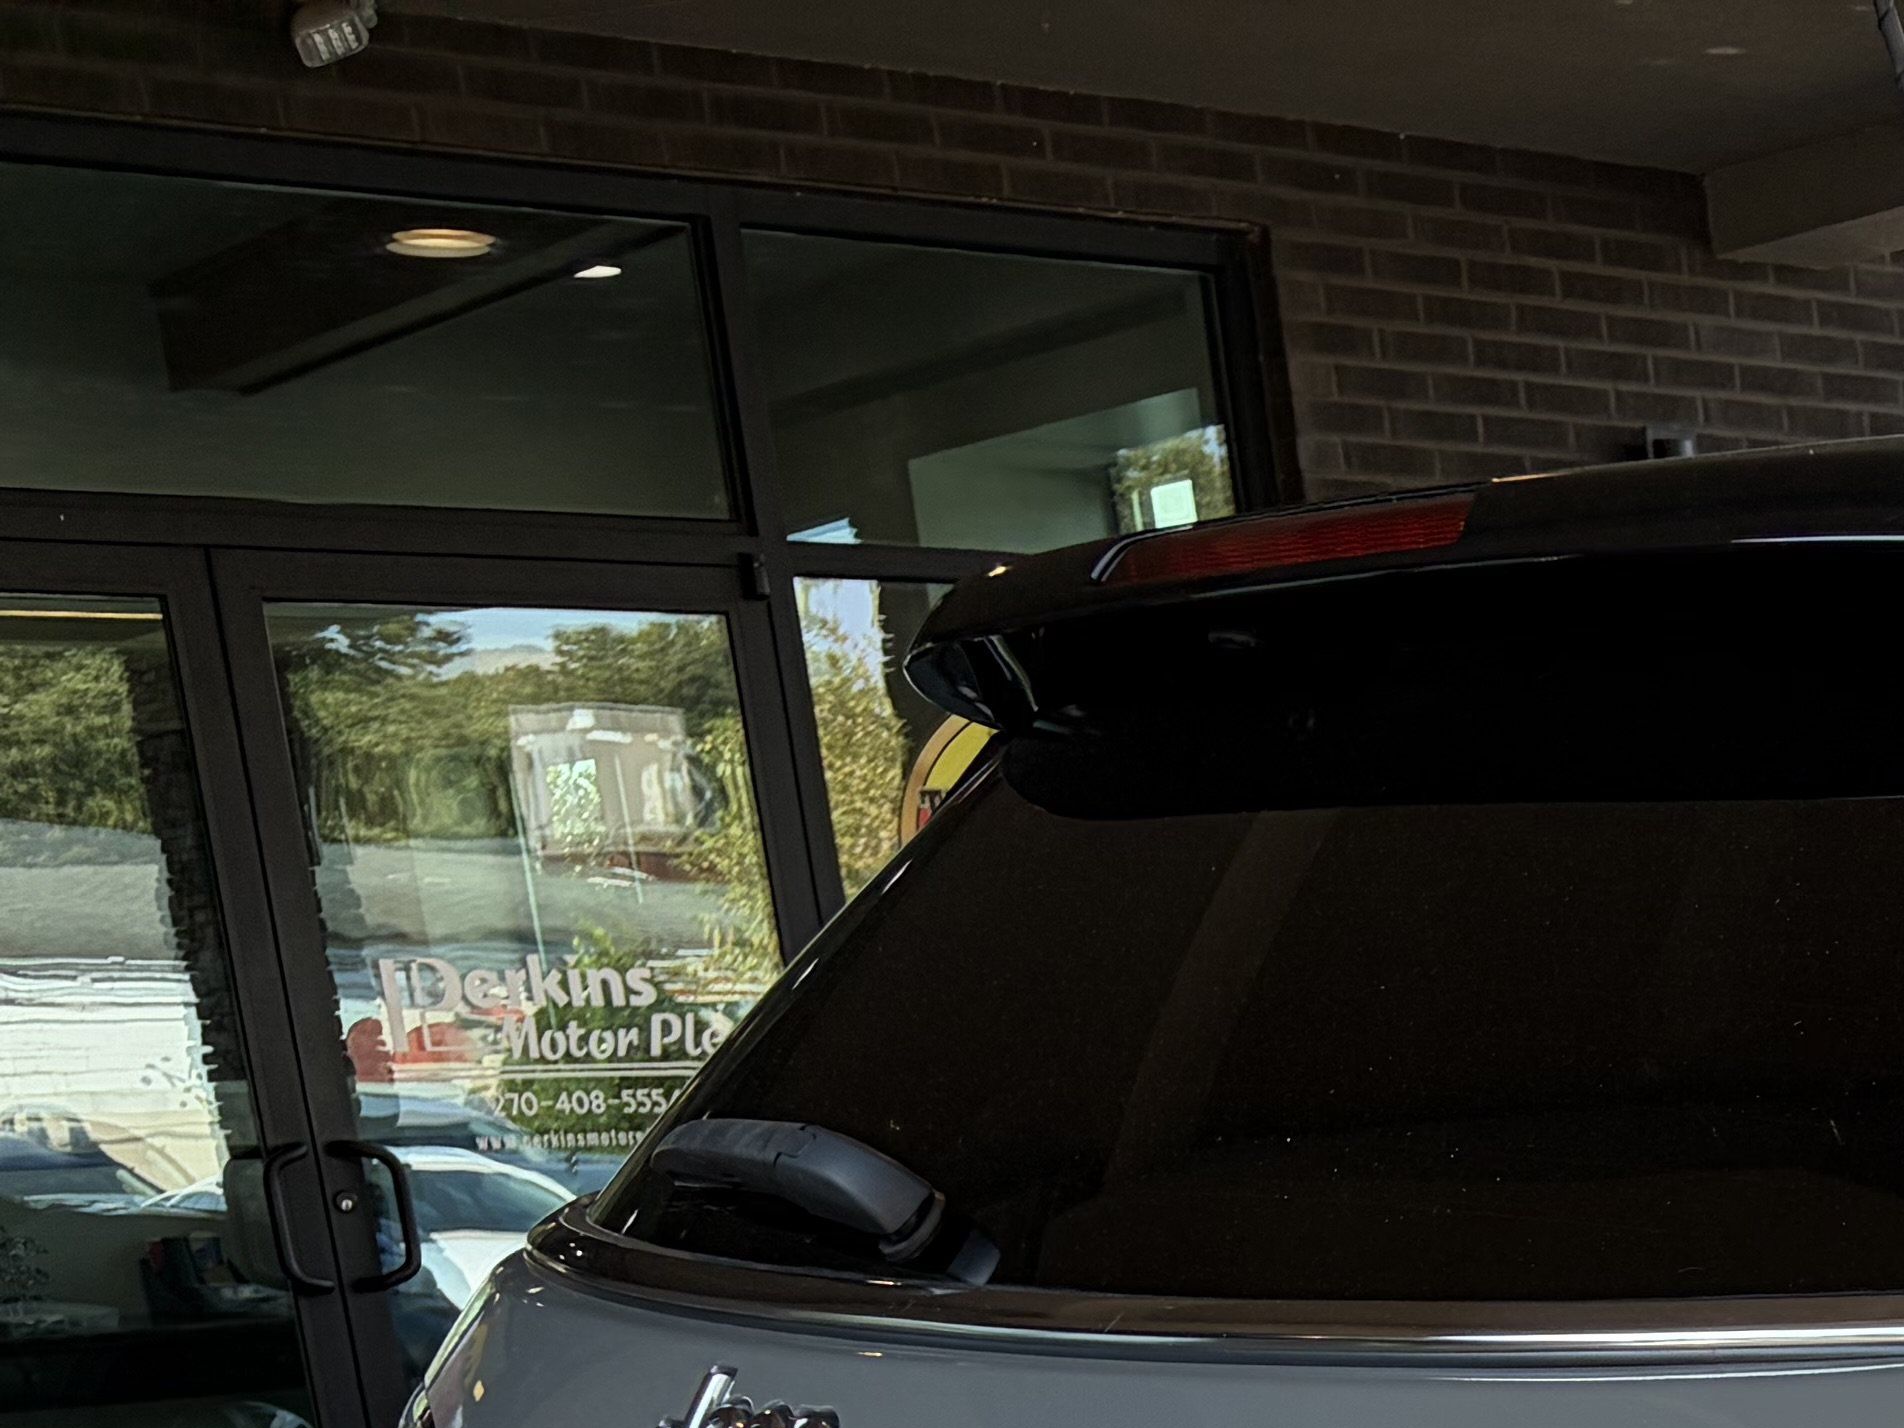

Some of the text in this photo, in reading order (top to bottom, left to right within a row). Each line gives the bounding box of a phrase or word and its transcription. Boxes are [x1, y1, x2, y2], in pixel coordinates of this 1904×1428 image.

[379, 954, 658, 1052] Perkins
[500, 1011, 724, 1061] Motor Ple
